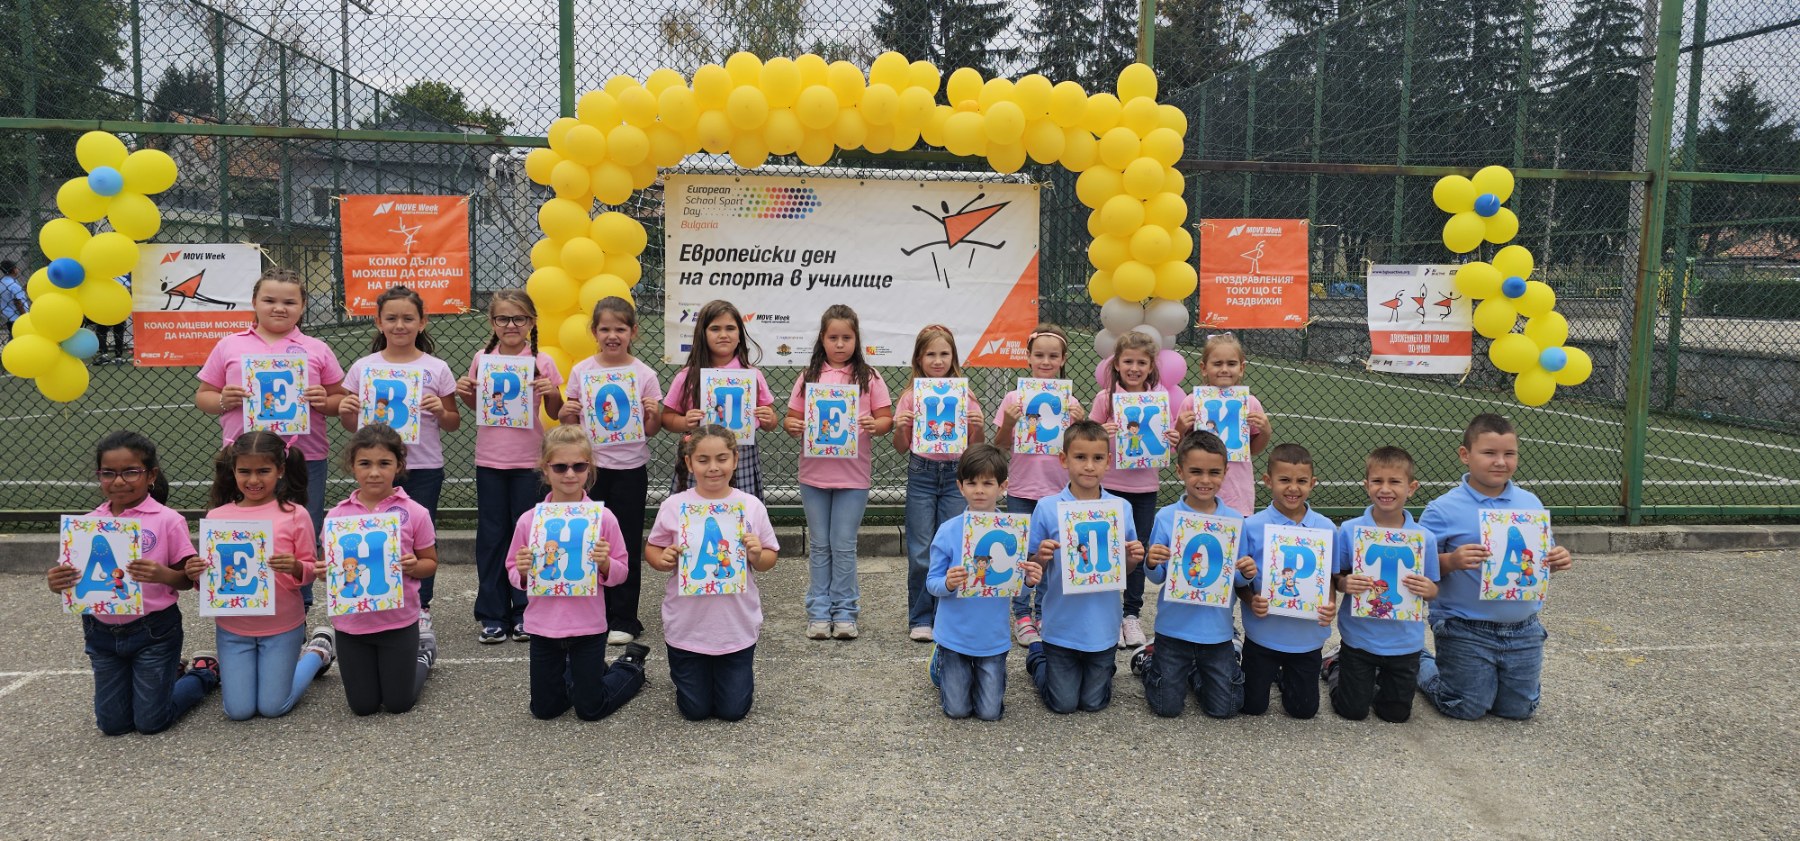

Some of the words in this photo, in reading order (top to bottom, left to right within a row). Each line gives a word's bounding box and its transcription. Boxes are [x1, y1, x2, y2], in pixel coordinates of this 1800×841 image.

[395, 203, 417, 212] MOVE
[418, 203, 439, 212] Week
[683, 206, 701, 217] Day
[685, 195, 717, 206] School
[719, 196, 744, 207] Sport
[687, 184, 731, 195] European
[680, 220, 719, 231] Bulgaria
[1245, 226, 1264, 234] MOVE
[1265, 226, 1282, 234] Week
[205, 252, 226, 260] Week
[352, 269, 397, 278] МОЖЕШ
[400, 269, 416, 279] ДА
[417, 268, 464, 278] СКАЧАШ
[368, 257, 408, 266] КОЛКО
[409, 257, 447, 267] ДЪЛГО
[678, 243, 797, 266] Европейски
[801, 249, 837, 267] ден
[367, 281, 383, 290] НА
[417, 279, 450, 289] КРАК?
[679, 271, 703, 286] на
[708, 271, 784, 290] спорта
[790, 269, 803, 287] в
[806, 273, 893, 291] училище
[1215, 275, 1294, 285] ПОЗДРАВЛЕНИЯ!
[1226, 286, 1250, 295] ТОКУ
[1252, 286, 1270, 296] ЩО
[1271, 286, 1283, 294] СЕ
[1226, 297, 1283, 307] РАЗДВИЖИ!
[143, 321, 175, 330] КОЛКО
[176, 321, 212, 330] ЛИЦЕВИ
[164, 332, 177, 340] ДА
[255, 370, 297, 421] Е
[372, 379, 409, 429] В
[490, 371, 521, 416] Р
[594, 383, 631, 432] О
[713, 387, 745, 429] П
[923, 384, 959, 441] Й
[815, 399, 848, 446] Е
[1025, 392, 1062, 442] С
[1123, 405, 1165, 456] К
[1204, 400, 1243, 450] И
[75, 534, 129, 600] Д
[216, 542, 259, 595] Е
[338, 530, 391, 598] Н
[539, 518, 589, 581] Н
[690, 516, 736, 580] А
[973, 529, 1018, 586] С
[1074, 520, 1111, 574] П
[1181, 532, 1224, 589] О
[1493, 525, 1538, 587] А
[1277, 544, 1317, 597] Р
[1365, 543, 1416, 605] Т
